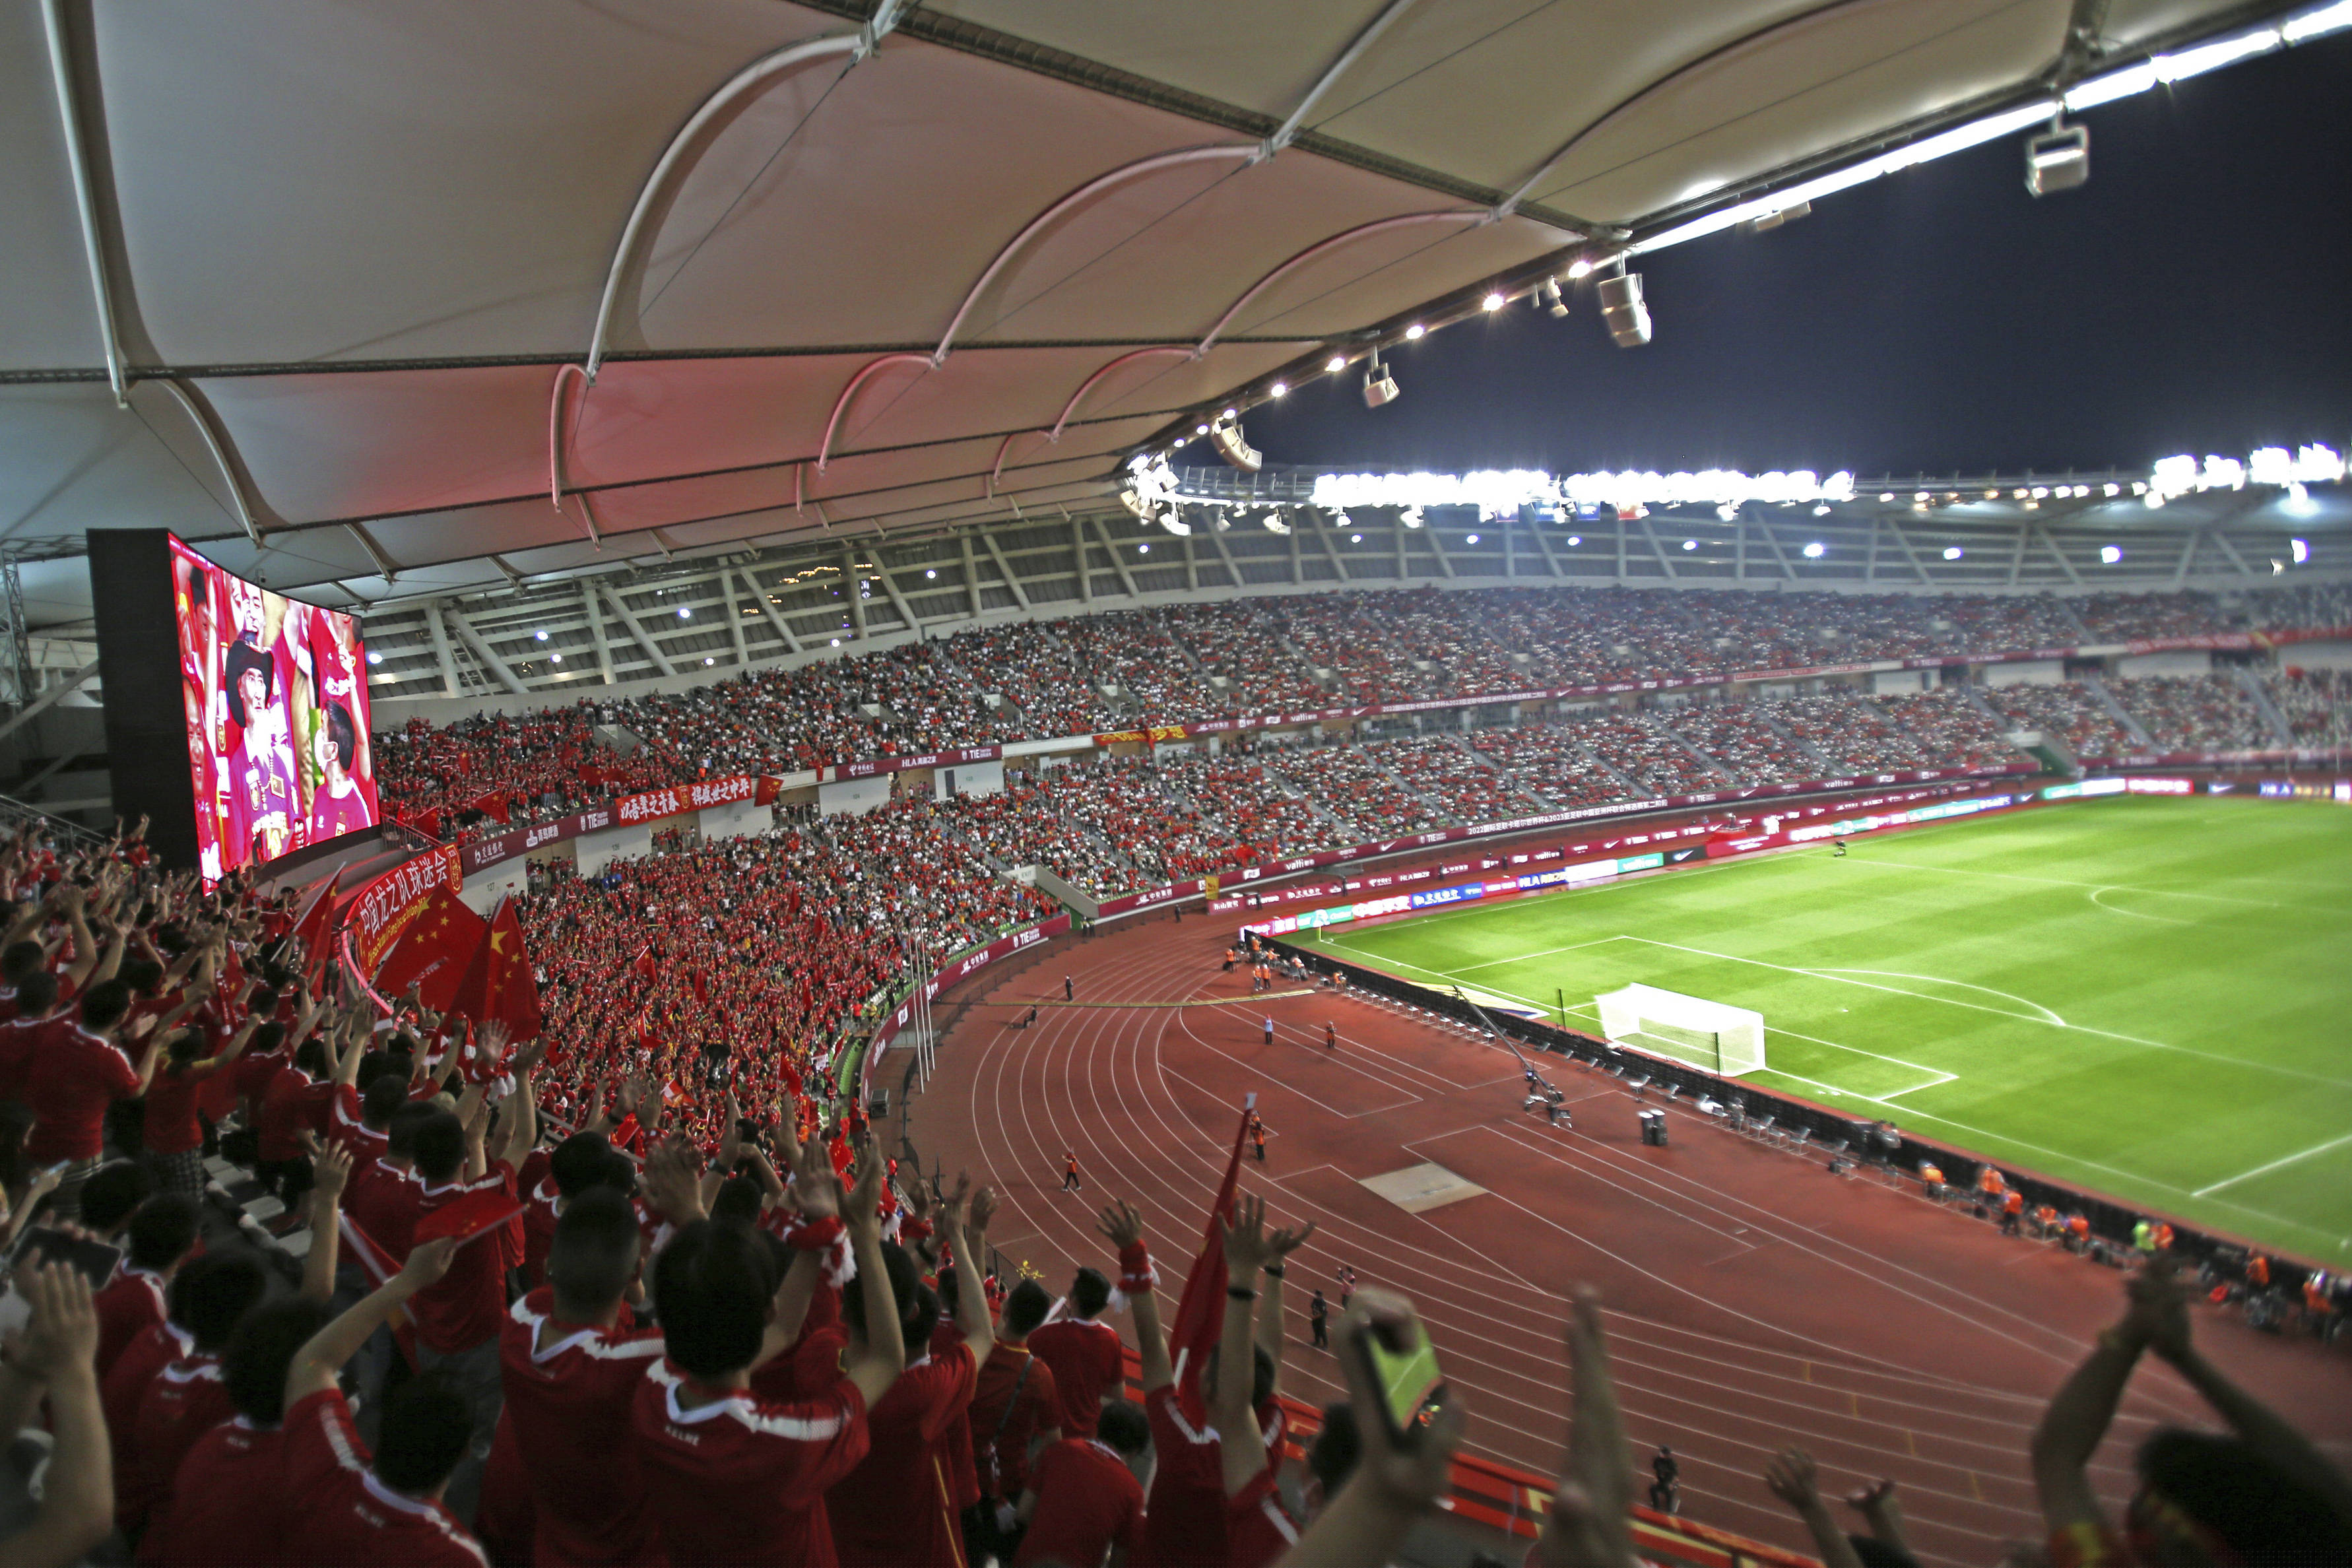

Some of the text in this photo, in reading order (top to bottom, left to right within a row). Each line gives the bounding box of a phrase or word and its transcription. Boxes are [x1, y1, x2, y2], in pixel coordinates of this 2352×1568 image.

[587, 813, 597, 829] TIE
[537, 824, 559, 842] 青岛啤酒
[482, 841, 504, 859] 交通银行
[359, 851, 447, 938] 中国龙之队球迷会
[1020, 931, 1030, 945] TIE
